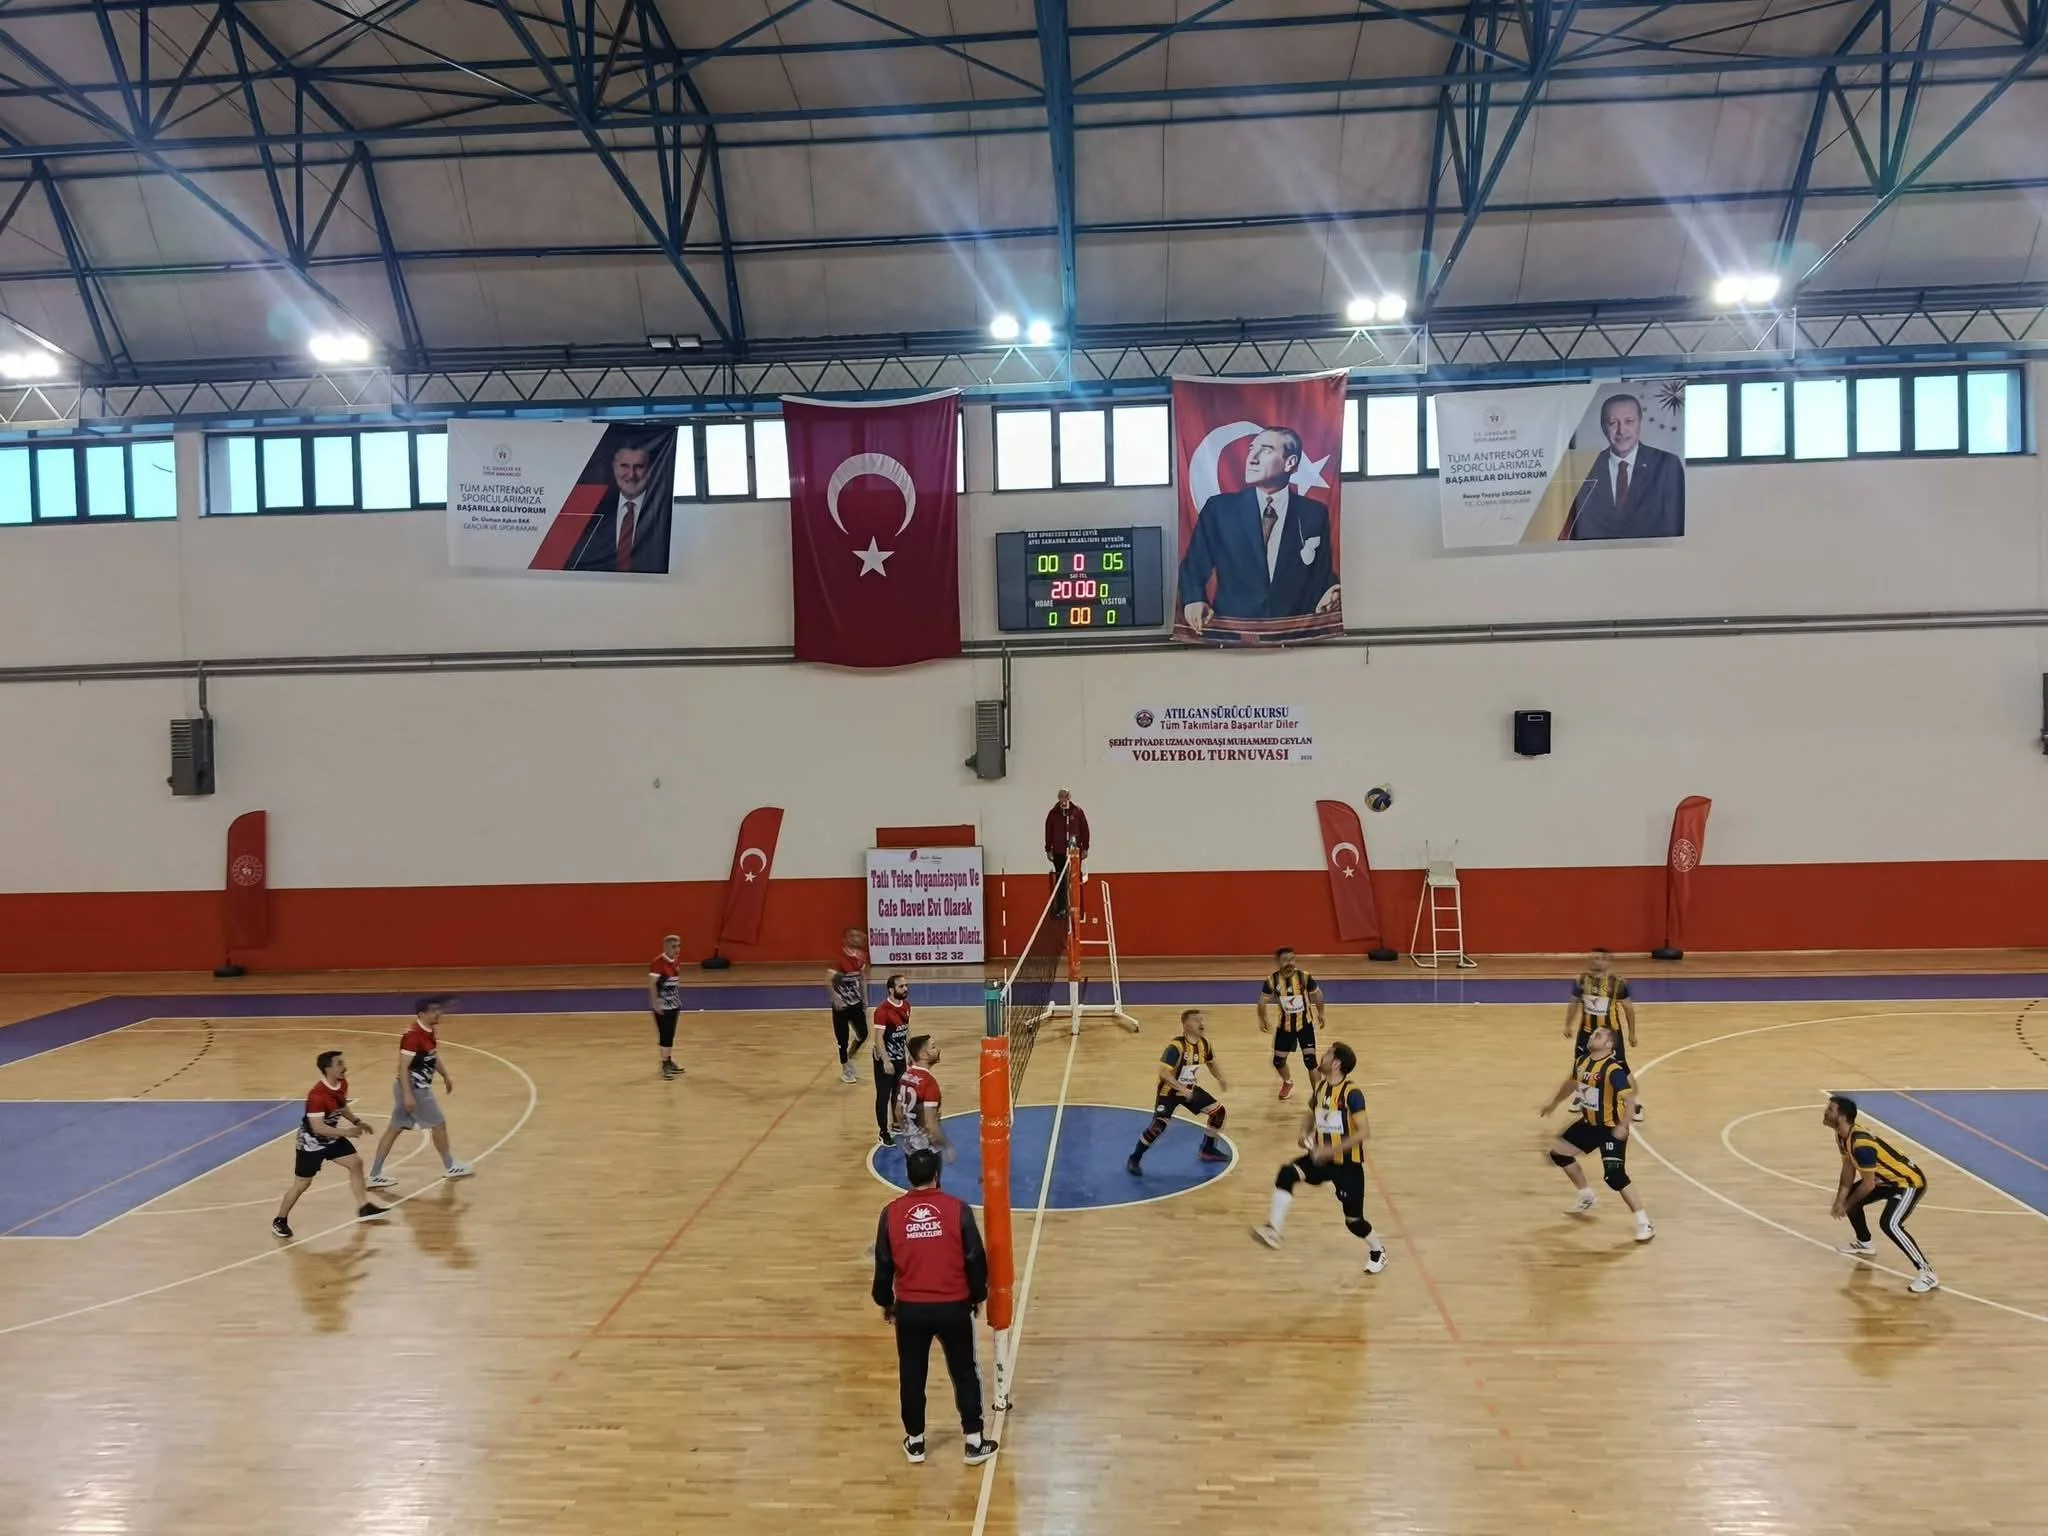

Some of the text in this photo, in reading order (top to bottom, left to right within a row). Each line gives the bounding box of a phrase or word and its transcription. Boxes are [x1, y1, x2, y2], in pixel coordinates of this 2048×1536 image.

[1448, 448, 1544, 463] TÜM ANTRENÖR VE
[1450, 460, 1542, 474] SPORCULARIMIZA
[1446, 470, 1547, 484] BAŞARILAR DİLİYORUM
[460, 483, 544, 496] TÜM ANTRENÖR VE
[462, 493, 542, 504] SPORCULARIMIZA
[457, 504, 546, 514] BAŞARILAR DİLİYORUM
[1038, 555, 1058, 572] 00
[1074, 554, 1084, 571] 0
[1103, 552, 1123, 570] 05
[1100, 584, 1108, 597] 0
[1101, 597, 1126, 606] VISITOR
[1049, 612, 1057, 626] 0
[1070, 607, 1090, 624] 00
[1106, 610, 1115, 624] 0
[1164, 705, 1289, 720] ATILGAN SÜRÜCÜ KURSU
[1160, 719, 1300, 730] Tüm Takımlara Başarılar Diler
[1109, 736, 1312, 748] ŞEHİT PİYADE UZMAN ONBAŞI MUHAMMED CEYLAN
[1132, 750, 1205, 762] VOLEYBOL
[1208, 748, 1289, 761] TURNUVASI
[871, 868, 979, 892] Tatlı Telaş Organizasyon Ve
[878, 897, 972, 917] Cafe Davet Evi Olarak
[870, 928, 889, 946] Bütün
[891, 928, 925, 946] Takımlara
[927, 926, 957, 950] Başarılar
[889, 952, 964, 961] 0531 661 32 32
